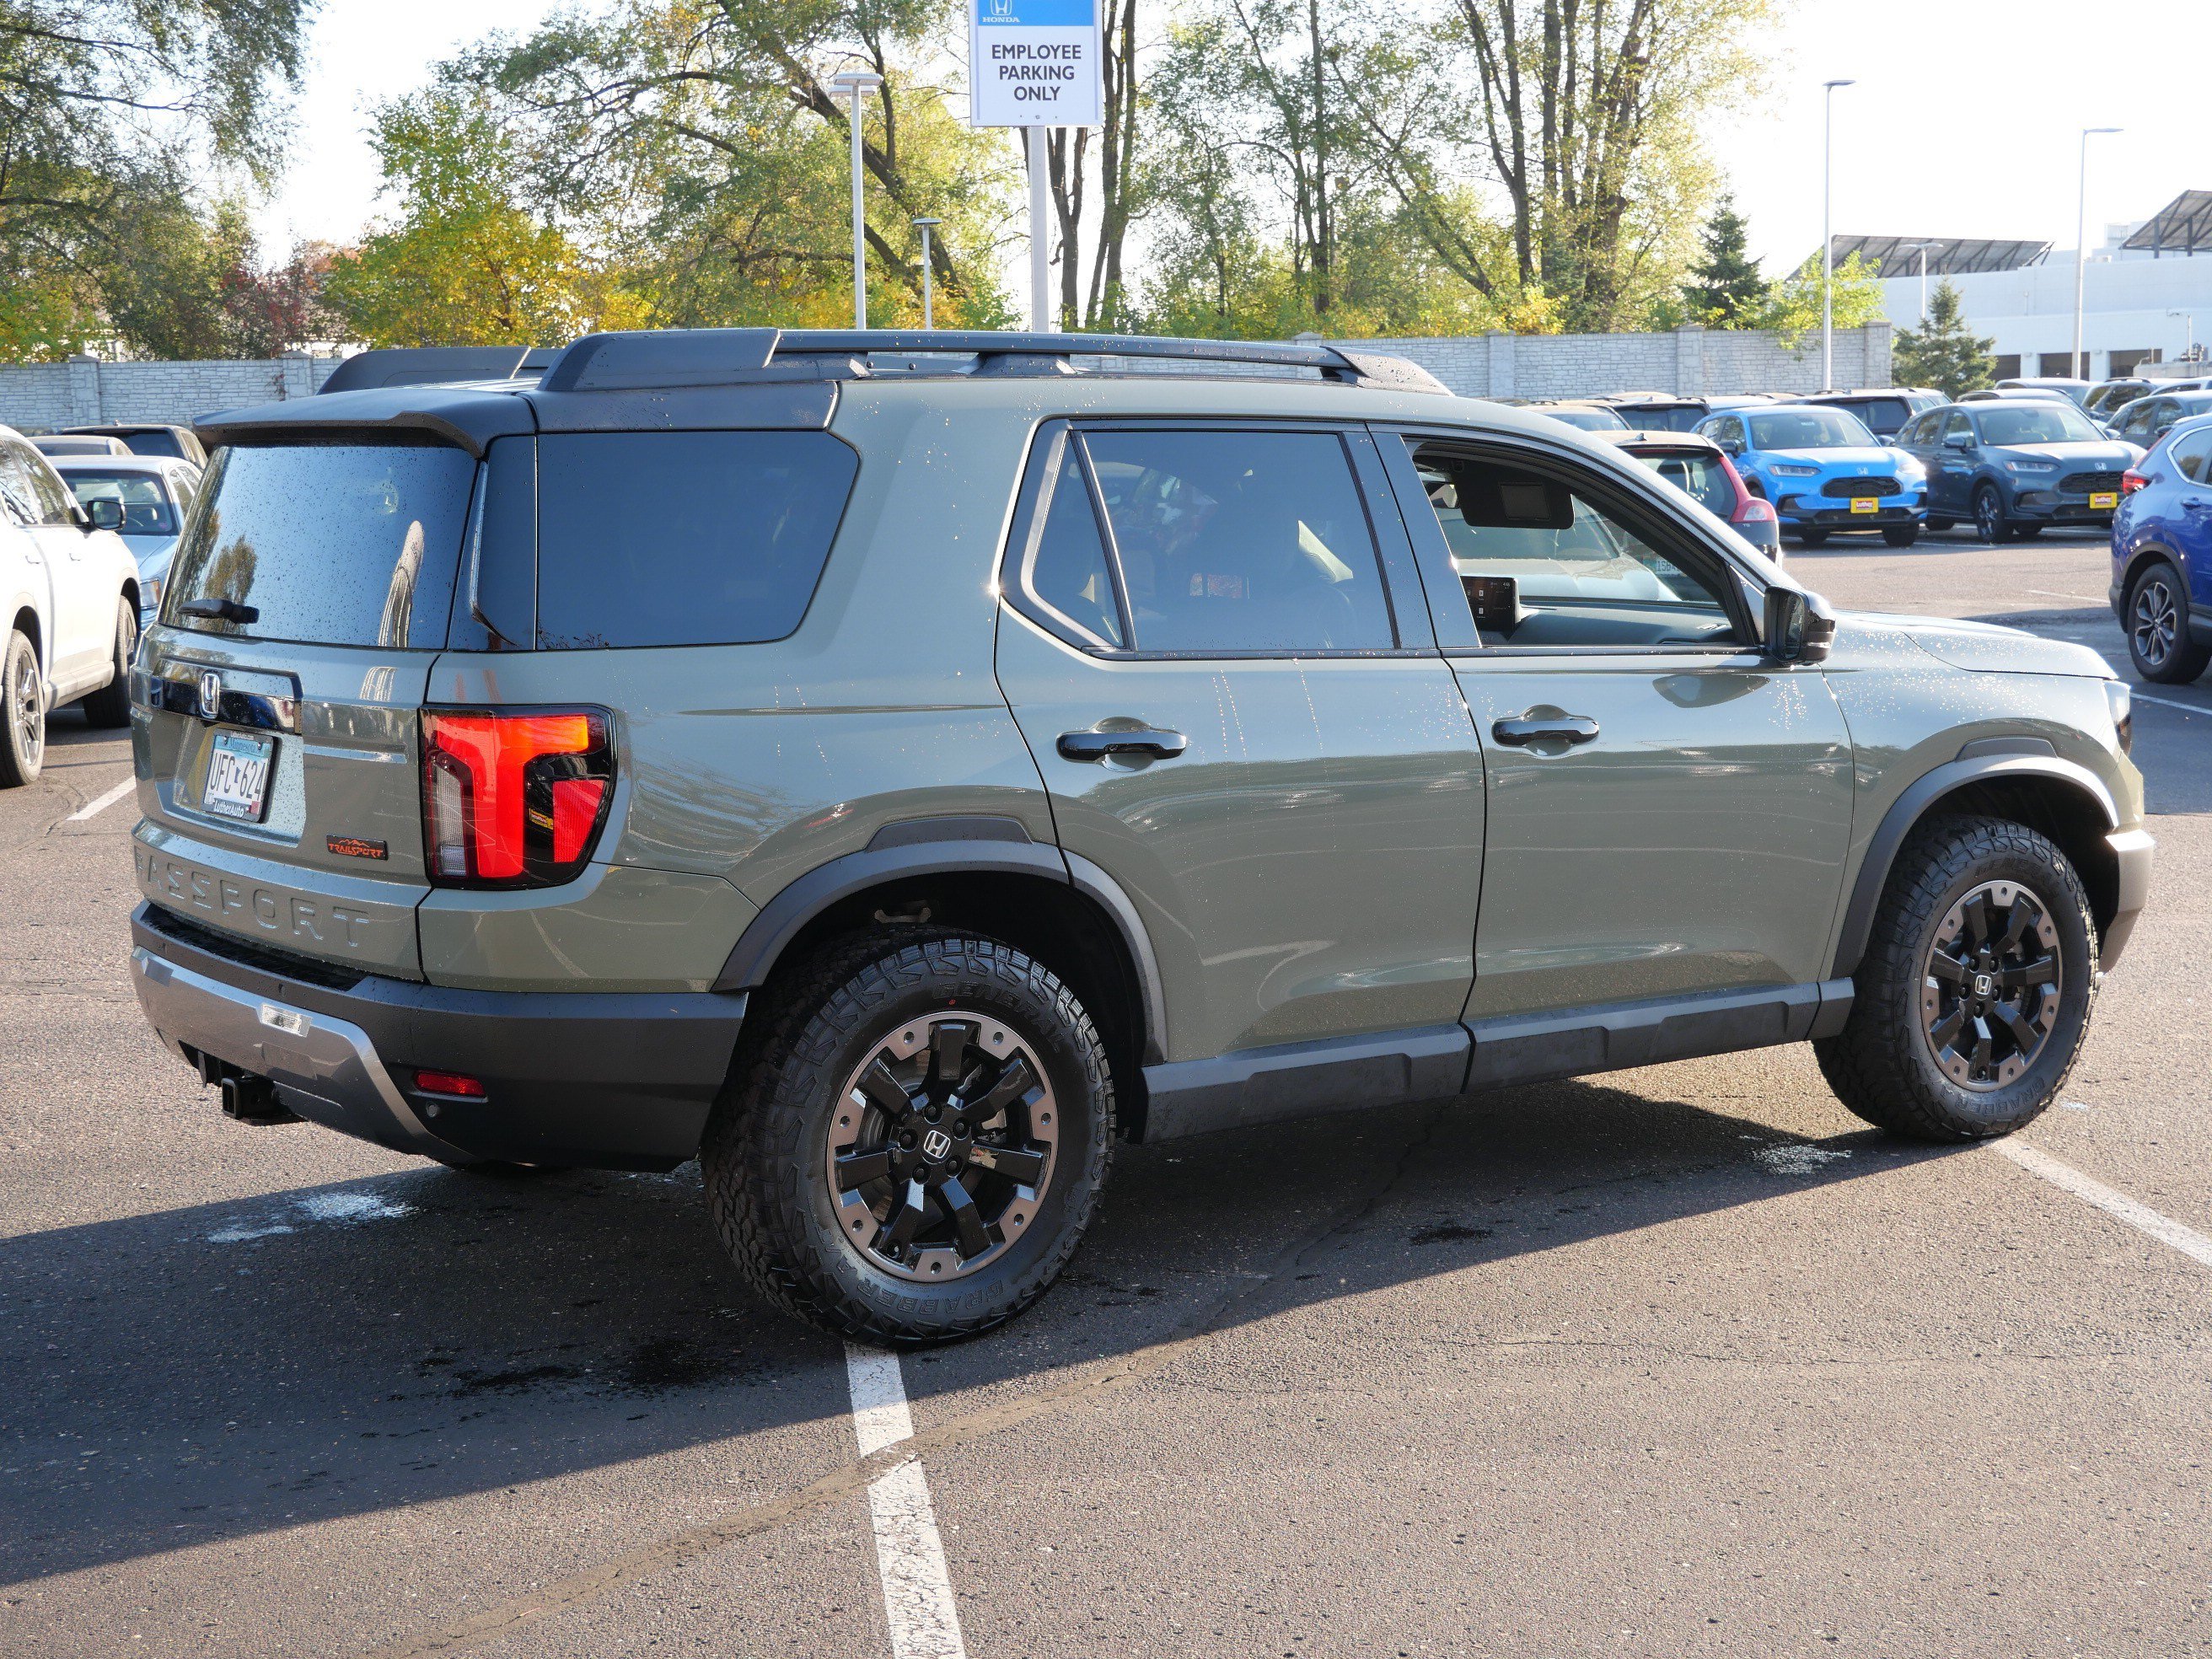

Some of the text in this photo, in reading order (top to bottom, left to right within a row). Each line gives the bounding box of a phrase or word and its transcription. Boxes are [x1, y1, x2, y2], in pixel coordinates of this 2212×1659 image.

[991, 45, 1082, 60] EMPLOYEE
[999, 65, 1075, 80] PARKING
[1013, 86, 1061, 101] ONLY
[210, 753, 266, 801] UFC 624
[328, 843, 384, 858] TRAILSPORT
[856, 1276, 1005, 1315] GRABBER
